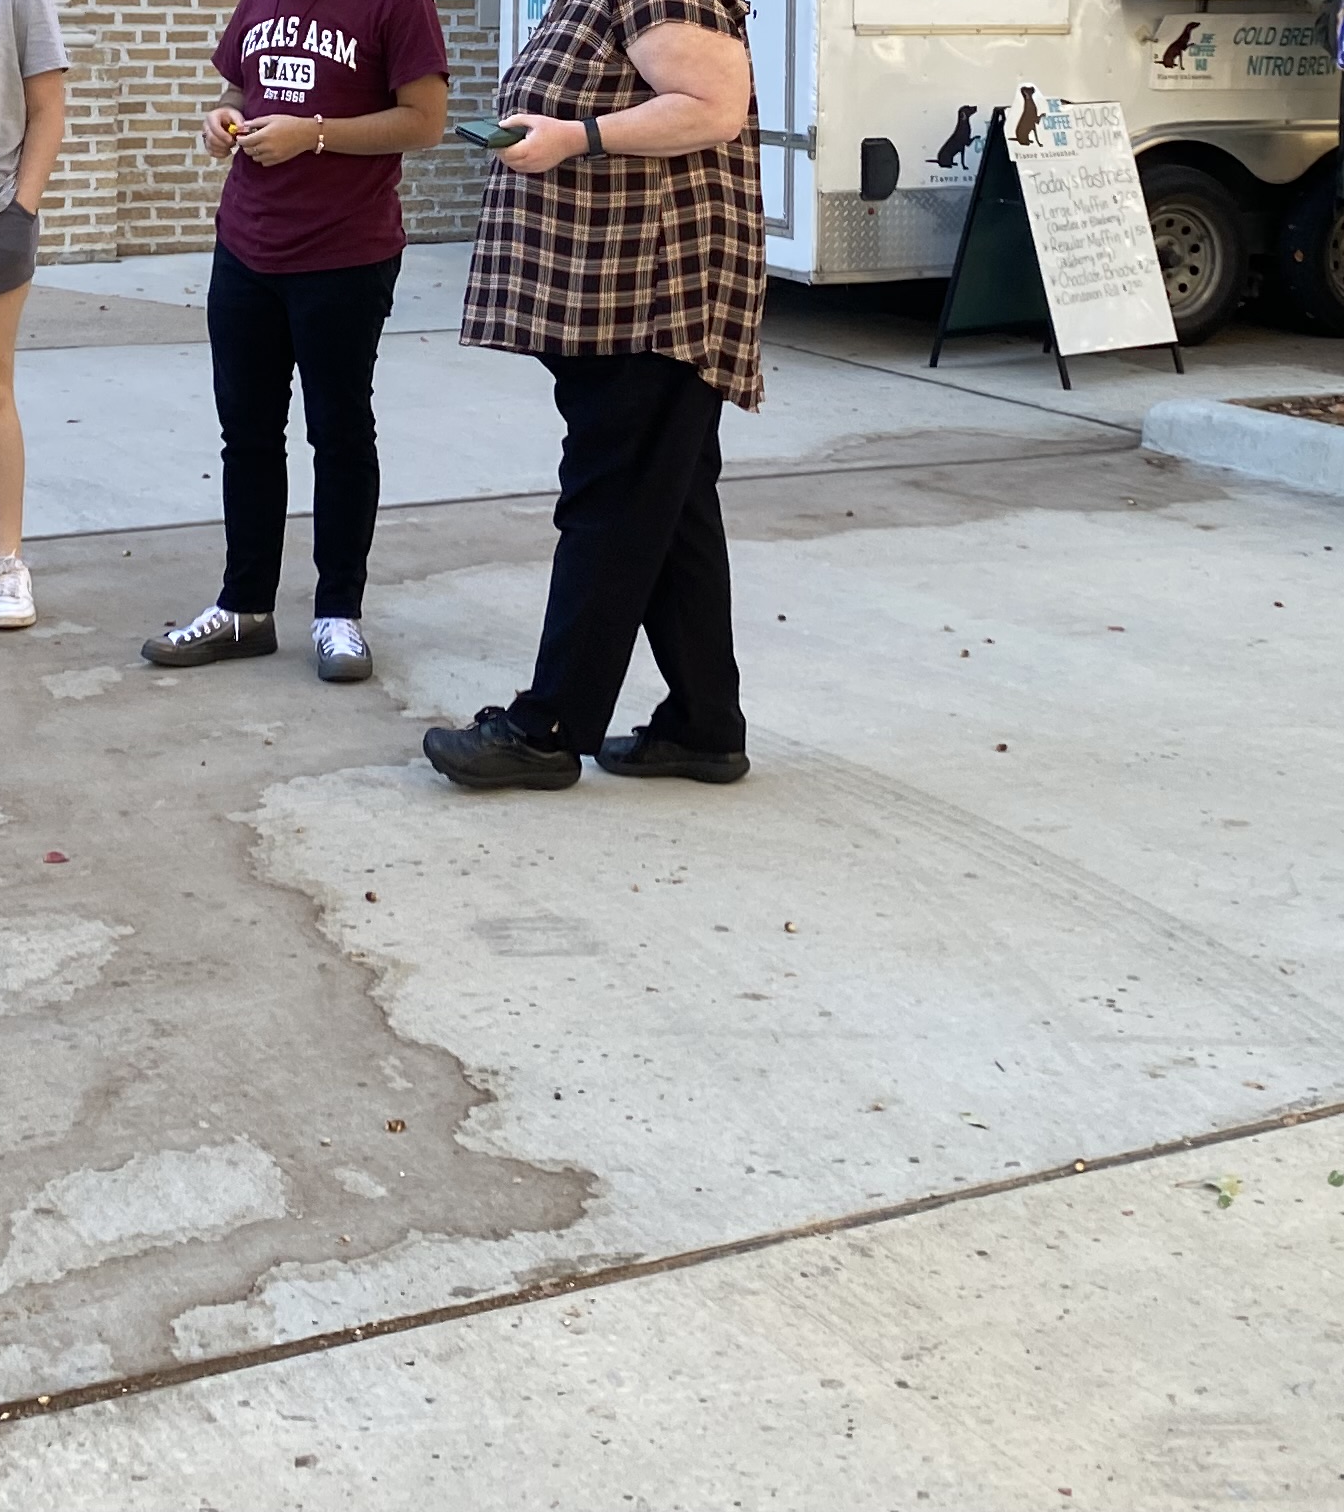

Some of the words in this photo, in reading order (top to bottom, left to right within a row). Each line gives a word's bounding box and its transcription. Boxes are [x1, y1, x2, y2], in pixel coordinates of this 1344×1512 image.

[241, 16, 300, 63] TEXAS
[302, 20, 358, 72] A&M
[1233, 26, 1277, 46] COLD
[1189, 45, 1216, 57] COFFEE
[264, 59, 311, 83] MAYS
[1247, 55, 1293, 76] NITRO
[280, 90, 305, 103] 1968
[1043, 115, 1072, 130] COFFEE
[1074, 106, 1120, 127] HOURS
